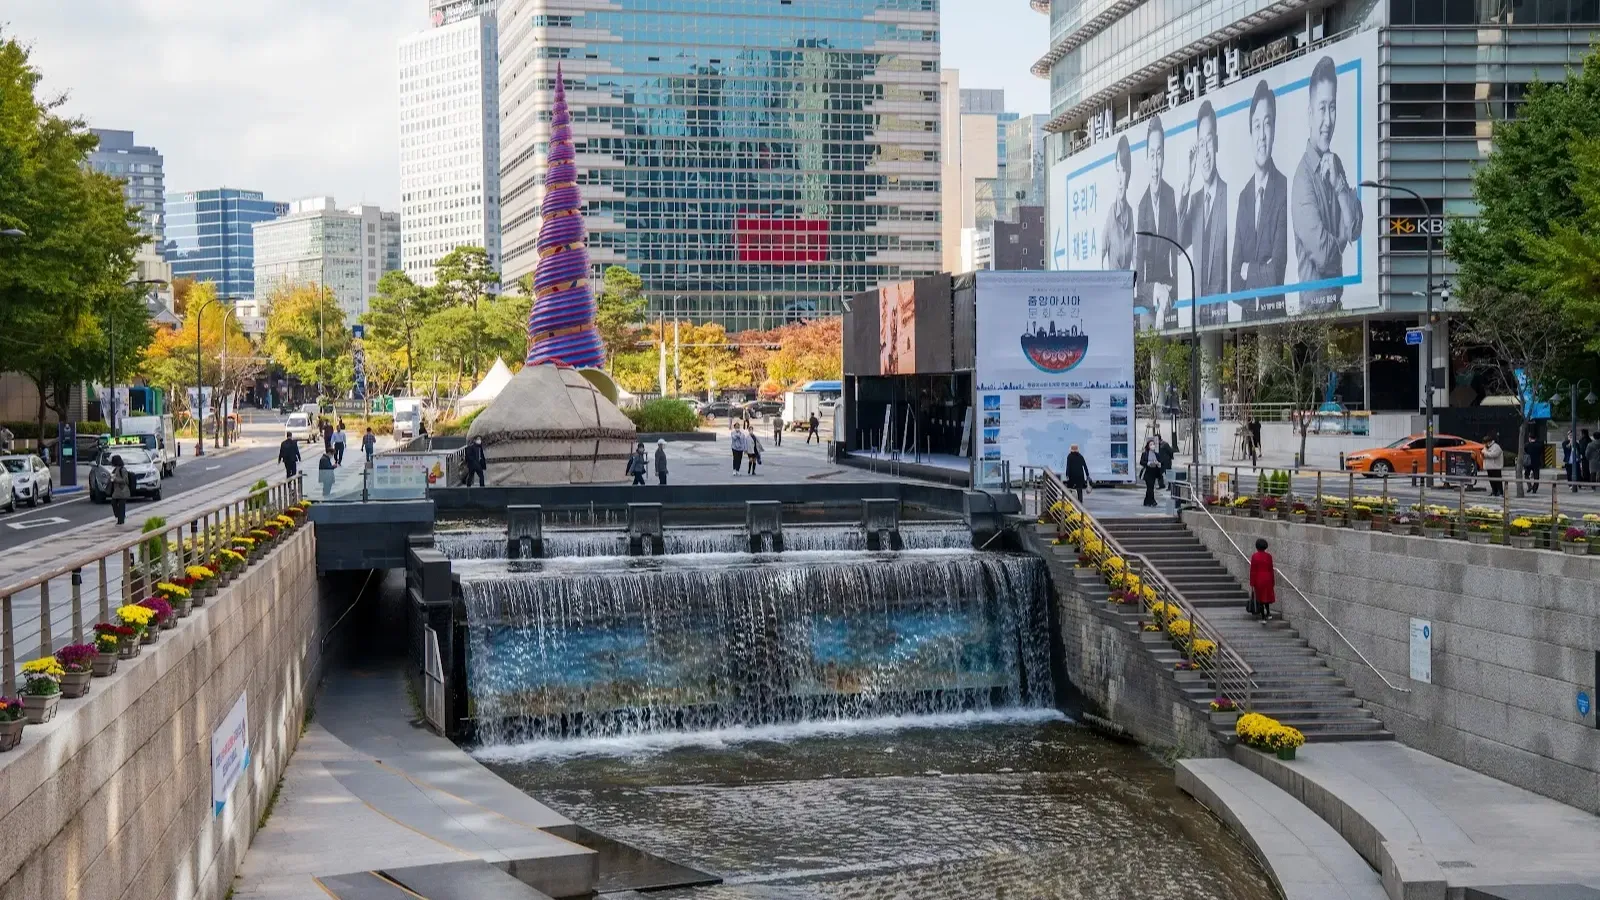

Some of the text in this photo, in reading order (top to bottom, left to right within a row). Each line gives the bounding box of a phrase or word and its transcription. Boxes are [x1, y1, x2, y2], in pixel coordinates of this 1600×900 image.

[1166, 48, 1242, 109] 동아일보
[1072, 182, 1098, 221] 우리가
[1417, 219, 1443, 233] KB
[1072, 227, 1097, 261] 채널A
[1028, 295, 1081, 307] 중앙아시아
